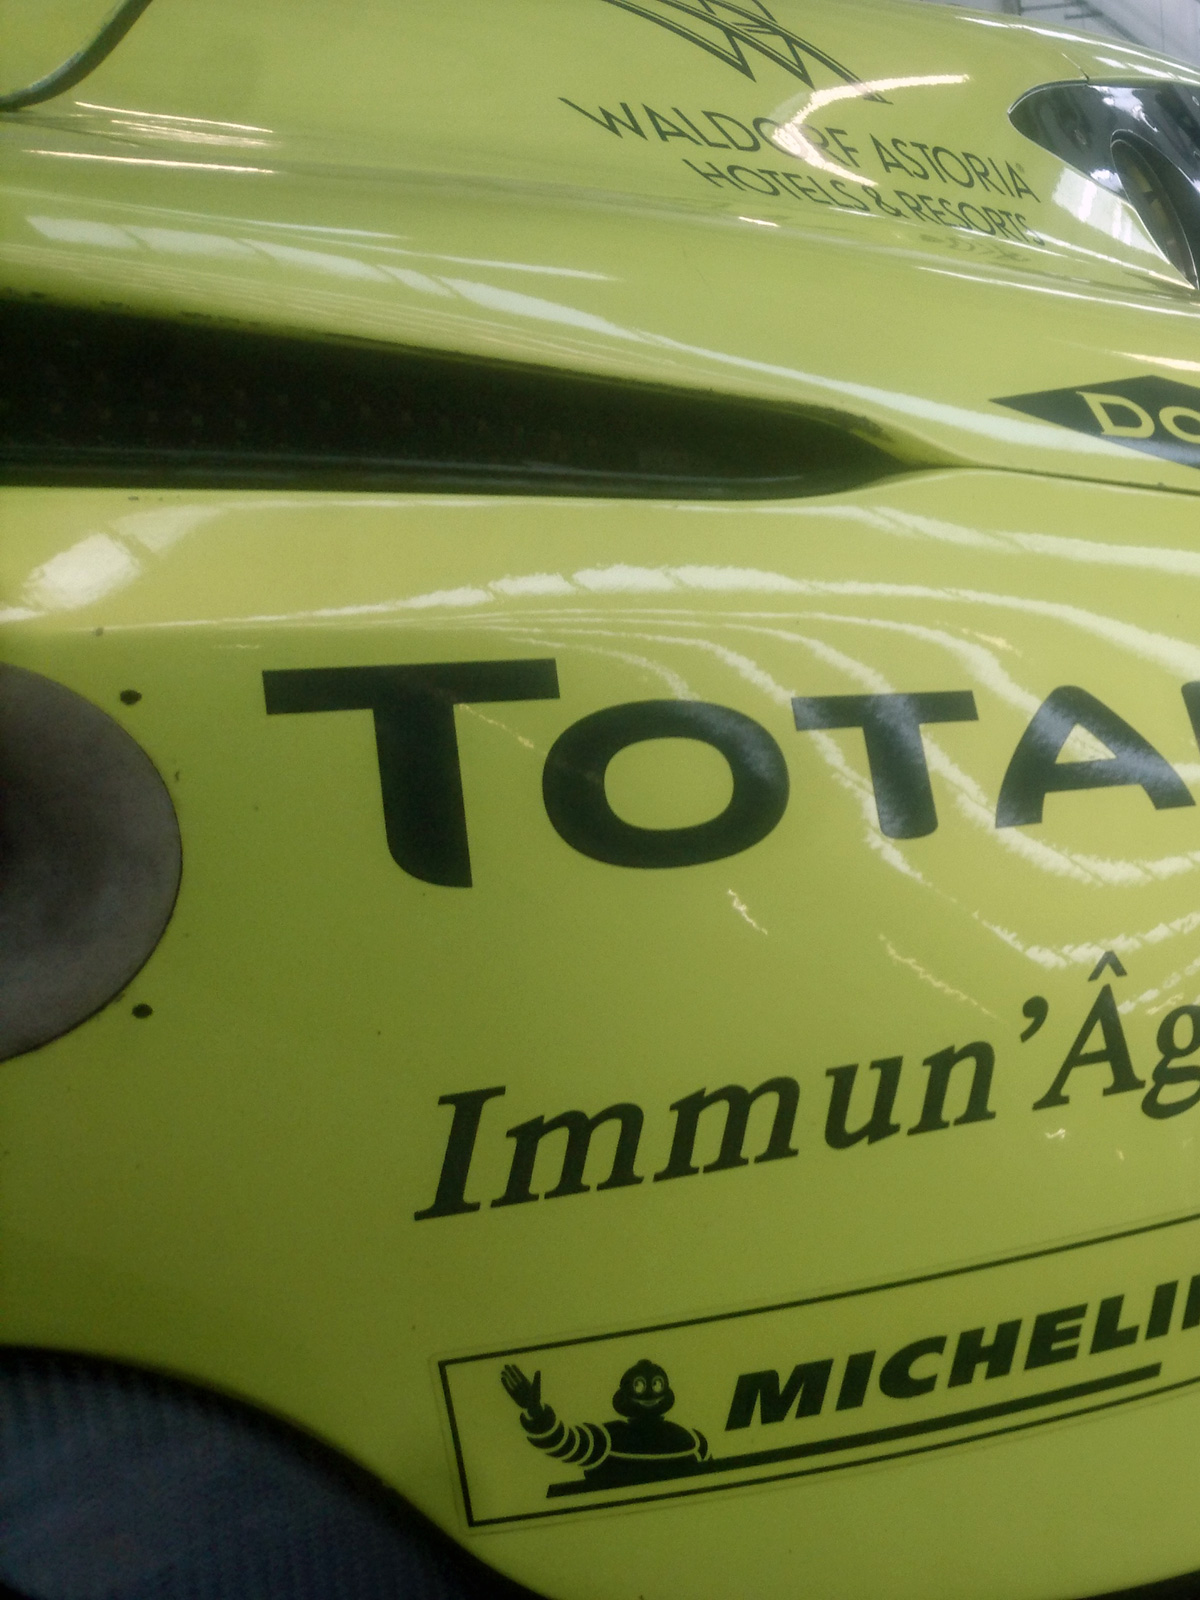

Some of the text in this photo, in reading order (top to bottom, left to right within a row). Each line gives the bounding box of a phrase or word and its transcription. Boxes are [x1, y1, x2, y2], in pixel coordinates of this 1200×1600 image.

[558, 97, 861, 168] WALDORF
[682, 158, 1046, 246] HOTELS & RESORTS
